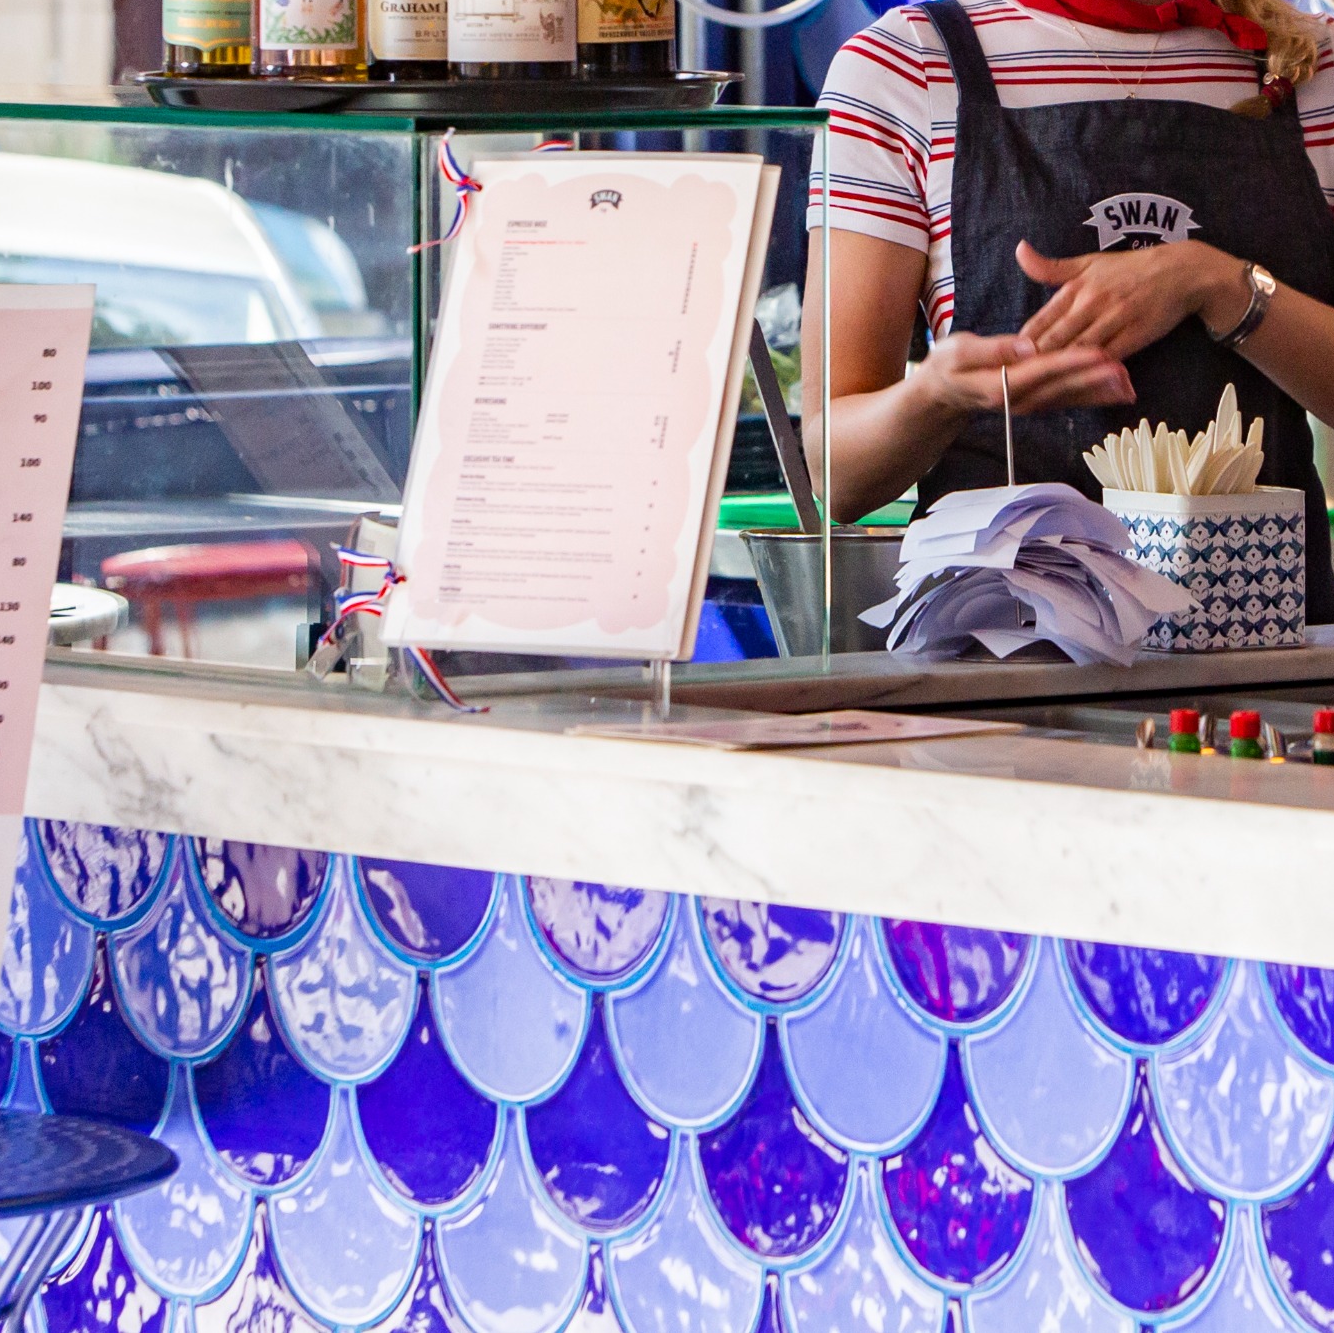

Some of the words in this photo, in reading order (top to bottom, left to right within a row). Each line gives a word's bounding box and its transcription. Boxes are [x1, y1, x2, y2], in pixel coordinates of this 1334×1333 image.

[380, 1, 440, 13] GRAHAM
[415, 30, 447, 38] BRUT
[1104, 200, 1180, 232] SWAN
[42, 349, 57, 358] 80
[31, 381, 52, 390] 100
[33, 414, 48, 423] 90
[20, 458, 41, 468] 100
[12, 513, 33, 523] 140
[12, 557, 27, 567] 80
[0, 602, 20, 612] 130
